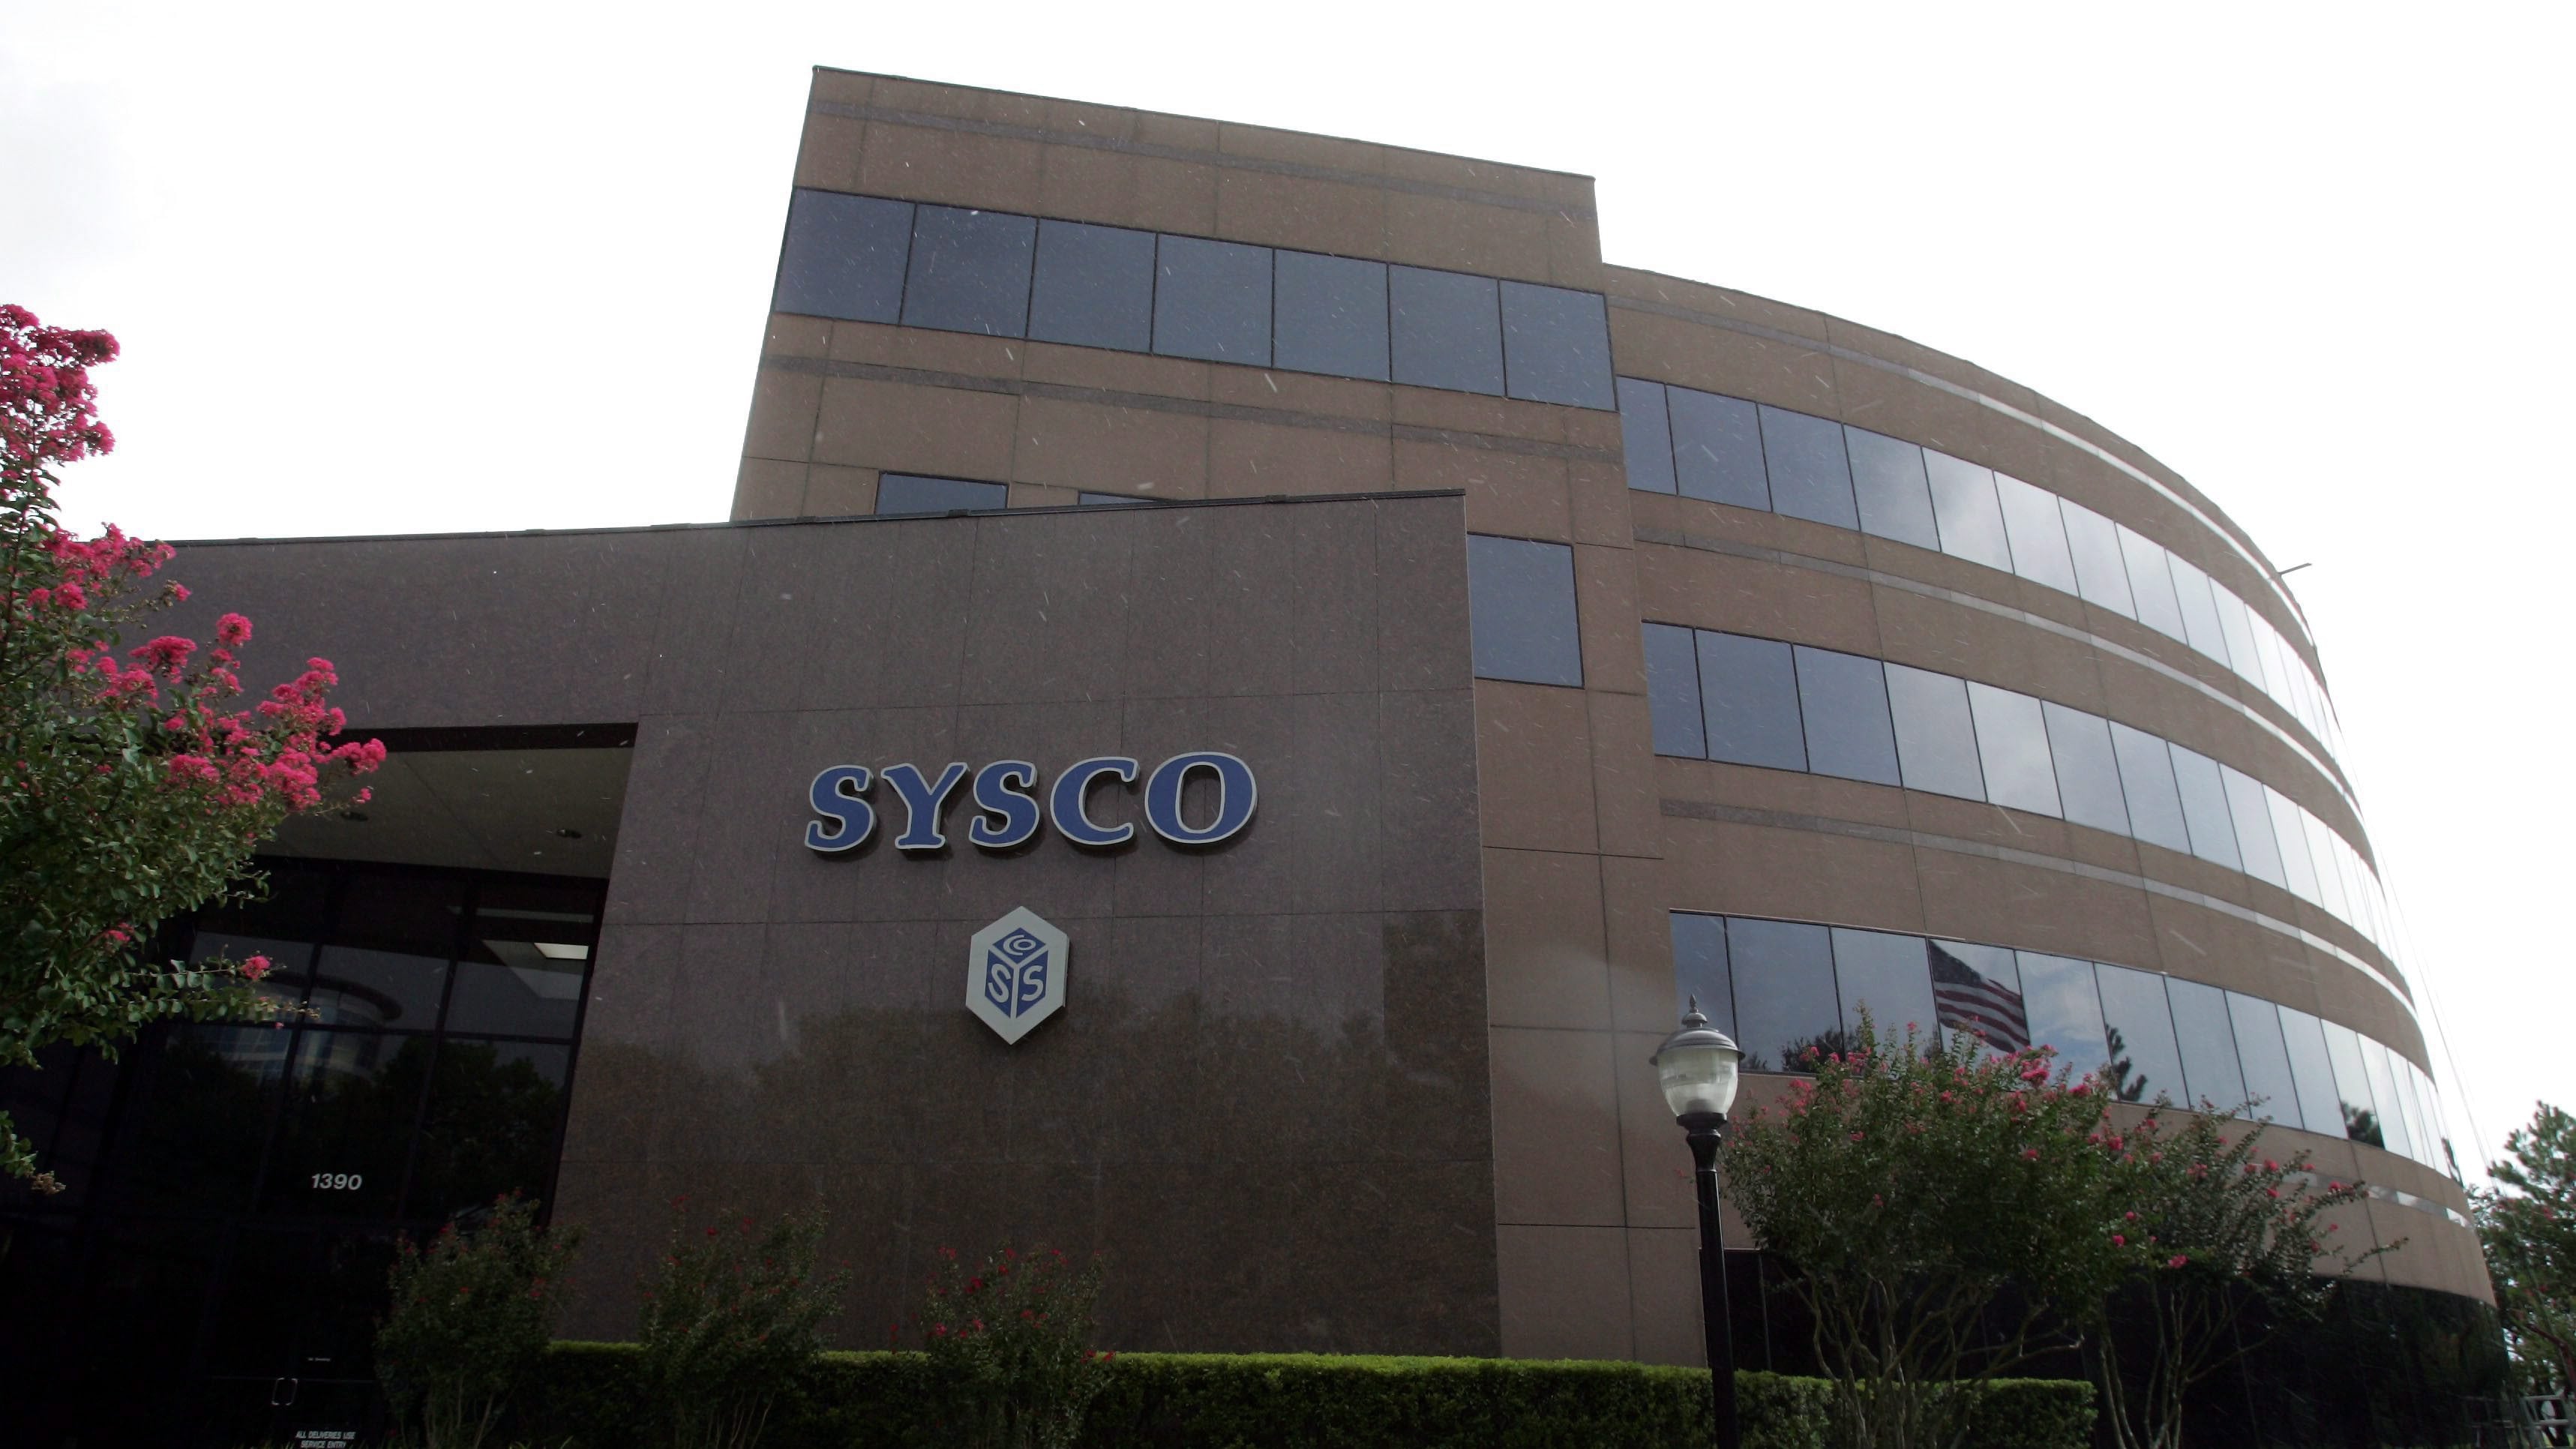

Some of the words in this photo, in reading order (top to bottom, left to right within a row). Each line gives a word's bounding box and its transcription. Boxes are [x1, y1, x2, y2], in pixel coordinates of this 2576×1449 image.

[805, 751, 1258, 852] SYSCO
[311, 1173, 363, 1191] 1390
[295, 1430, 306, 1438] ALL
[308, 1430, 342, 1439] DELIVERIES
[301, 1440, 325, 1448] SERVICE
[327, 1441, 346, 1449] ENTRY
